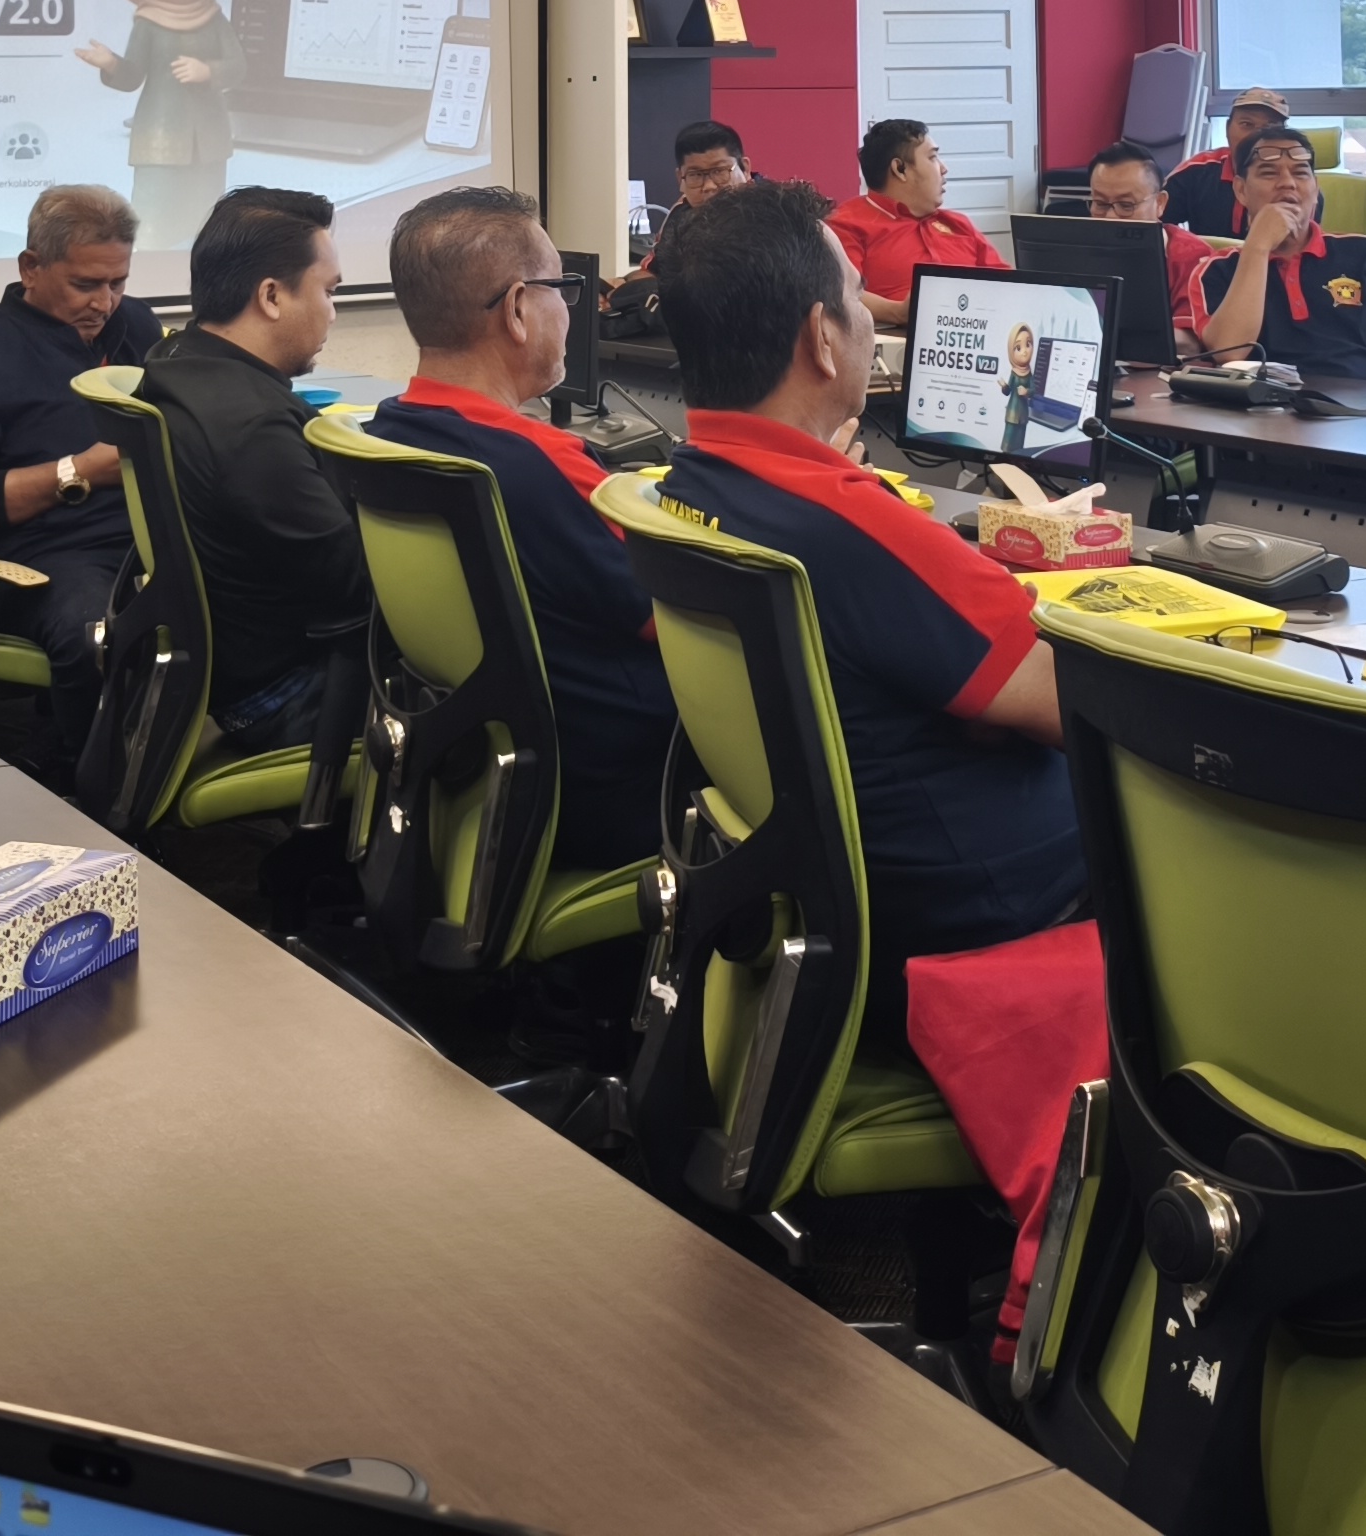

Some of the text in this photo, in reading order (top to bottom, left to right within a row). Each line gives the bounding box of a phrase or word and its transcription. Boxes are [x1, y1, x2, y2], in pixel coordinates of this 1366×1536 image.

[936, 315, 988, 330] ROADSHOW
[935, 330, 985, 351] SISTEM
[918, 348, 998, 373] EROSES V2.0
[31, 922, 99, 984] Superior
